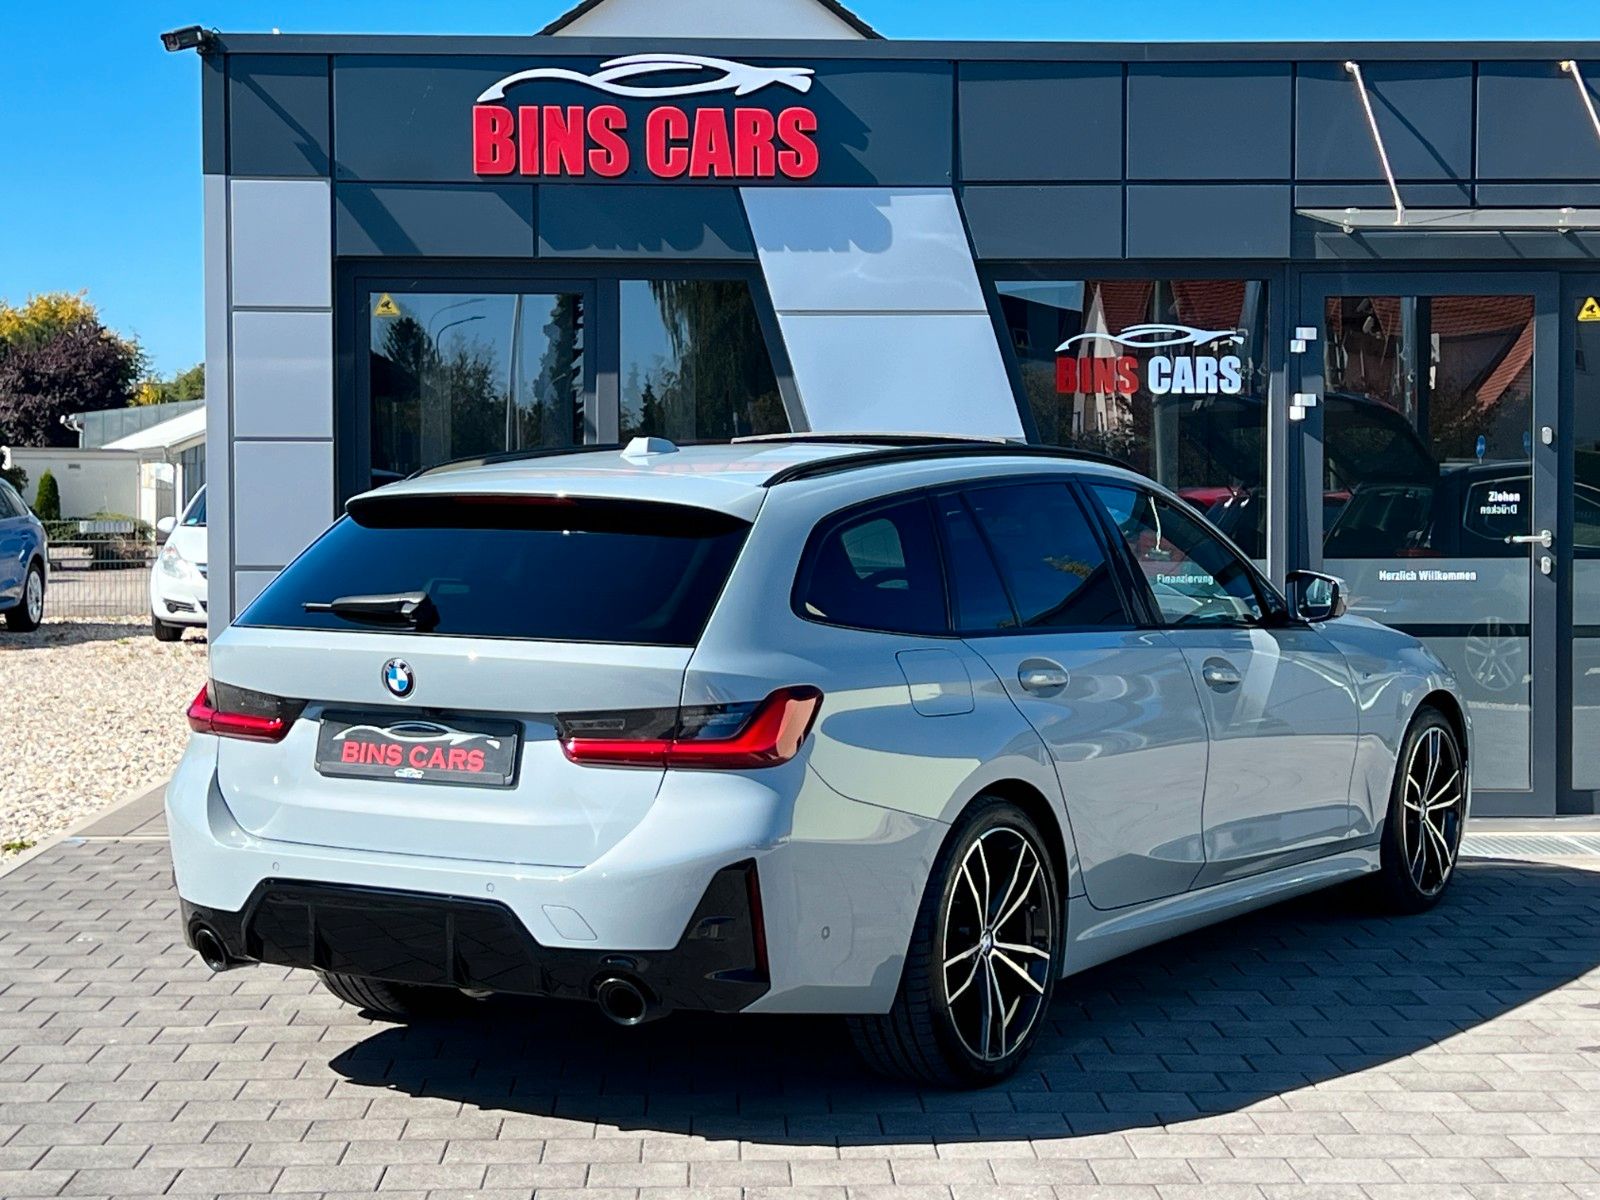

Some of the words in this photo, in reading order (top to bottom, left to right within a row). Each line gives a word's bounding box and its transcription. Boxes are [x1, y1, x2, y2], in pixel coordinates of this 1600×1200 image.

[472, 105, 630, 177] BINS
[646, 106, 819, 178] CARS
[1056, 357, 1139, 394] BINS
[1148, 356, 1242, 394] CARS
[1488, 491, 1521, 502] Ziehen
[1156, 573, 1214, 586] Finanzierung
[1379, 570, 1417, 581] Herzlich
[1419, 570, 1477, 581] Willkommen
[341, 741, 403, 768] BINS
[408, 745, 486, 772] CARS
